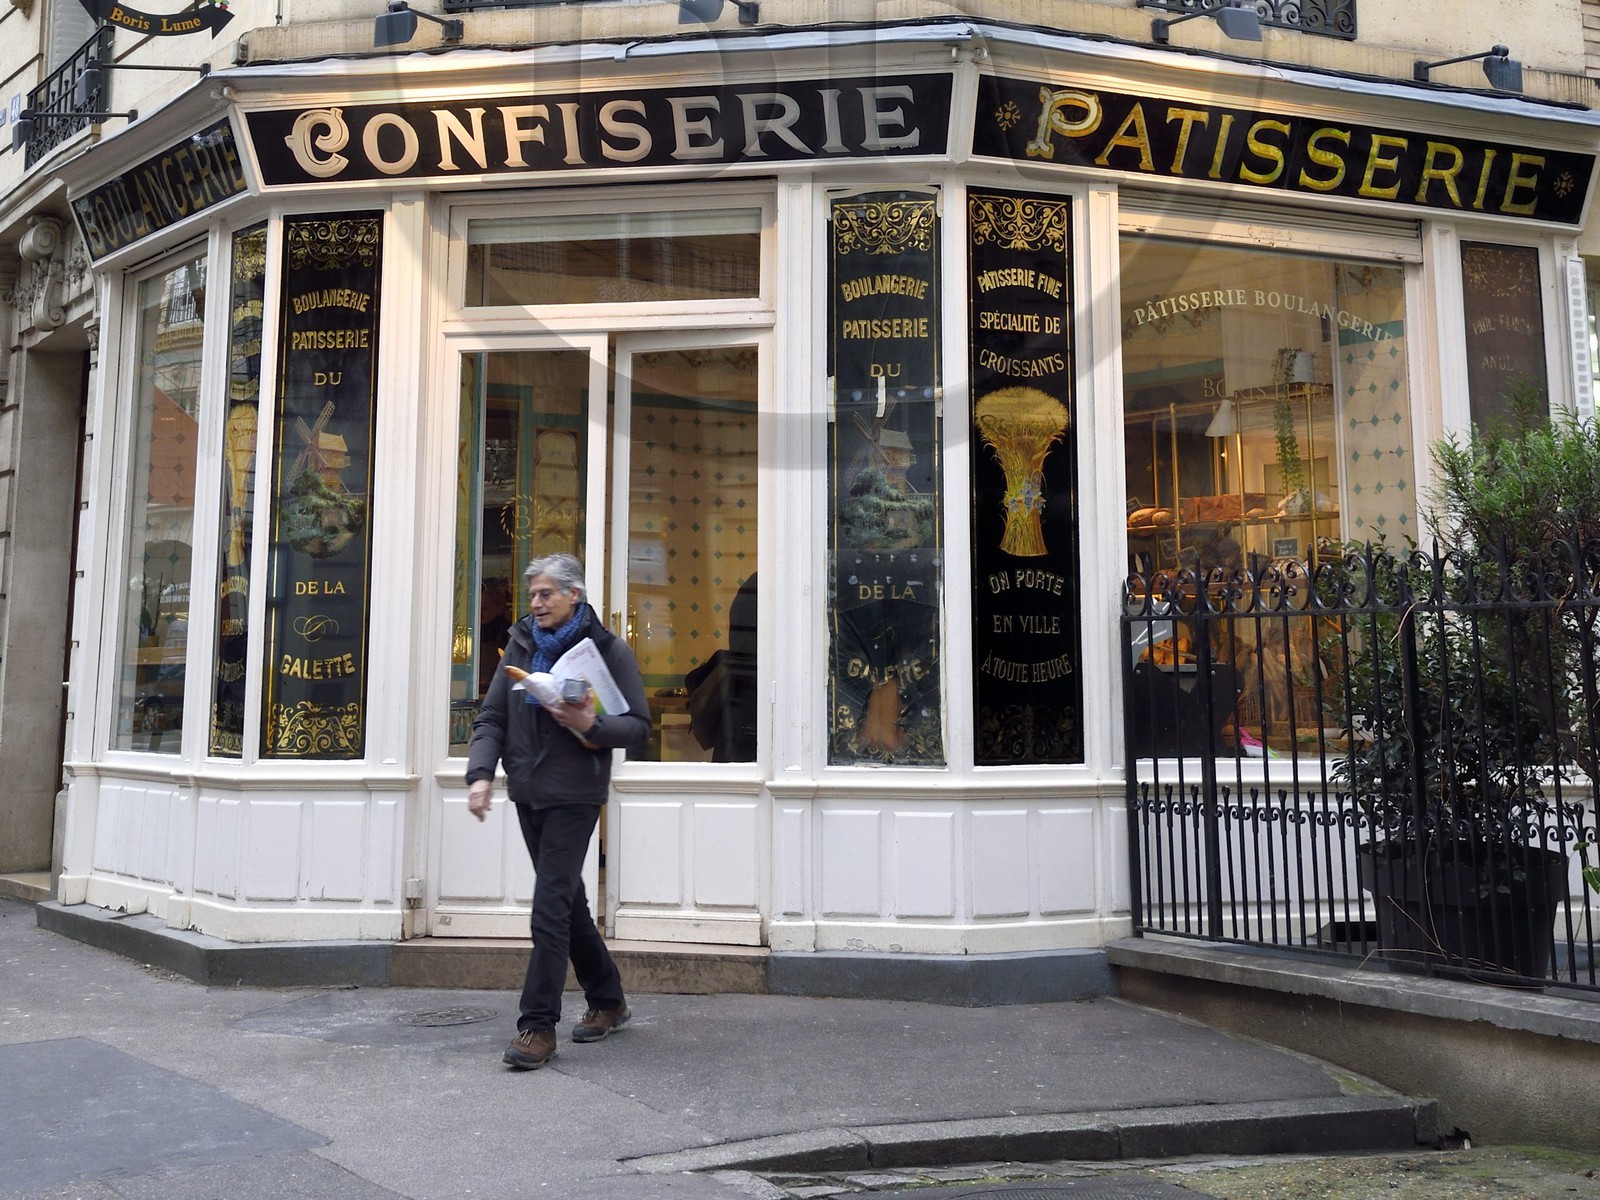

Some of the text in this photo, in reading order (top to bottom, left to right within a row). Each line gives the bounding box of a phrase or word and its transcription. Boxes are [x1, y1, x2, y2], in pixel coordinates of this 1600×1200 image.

[109, 7, 202, 32] Boris Lume
[284, 84, 920, 178] CONFISERIE
[1026, 86, 1547, 216] PATISSERIE
[79, 125, 247, 257] BOULANGERIE
[840, 274, 929, 302] BOULANGERIE
[1037, 272, 1062, 299] FINE
[292, 288, 371, 315] BOULANGERIE
[842, 317, 929, 339] PATISSERIE
[980, 309, 1061, 335] SPÉCIALITÉ DE
[1133, 289, 1394, 343] PÂTISSERIE BOULANGERIE
[291, 328, 369, 350] PATISSERIE
[870, 363, 902, 378] DU
[980, 348, 1065, 378] CROISSANTS
[313, 371, 343, 386] DU
[295, 581, 346, 596] DE LA
[859, 585, 916, 600] DE LA
[989, 568, 1064, 596] ON PORTE
[993, 614, 1060, 634] EN VILLE
[279, 652, 356, 680] GALETTE
[993, 657, 1028, 682] TOUTE
[1031, 653, 1072, 683] HEURE
